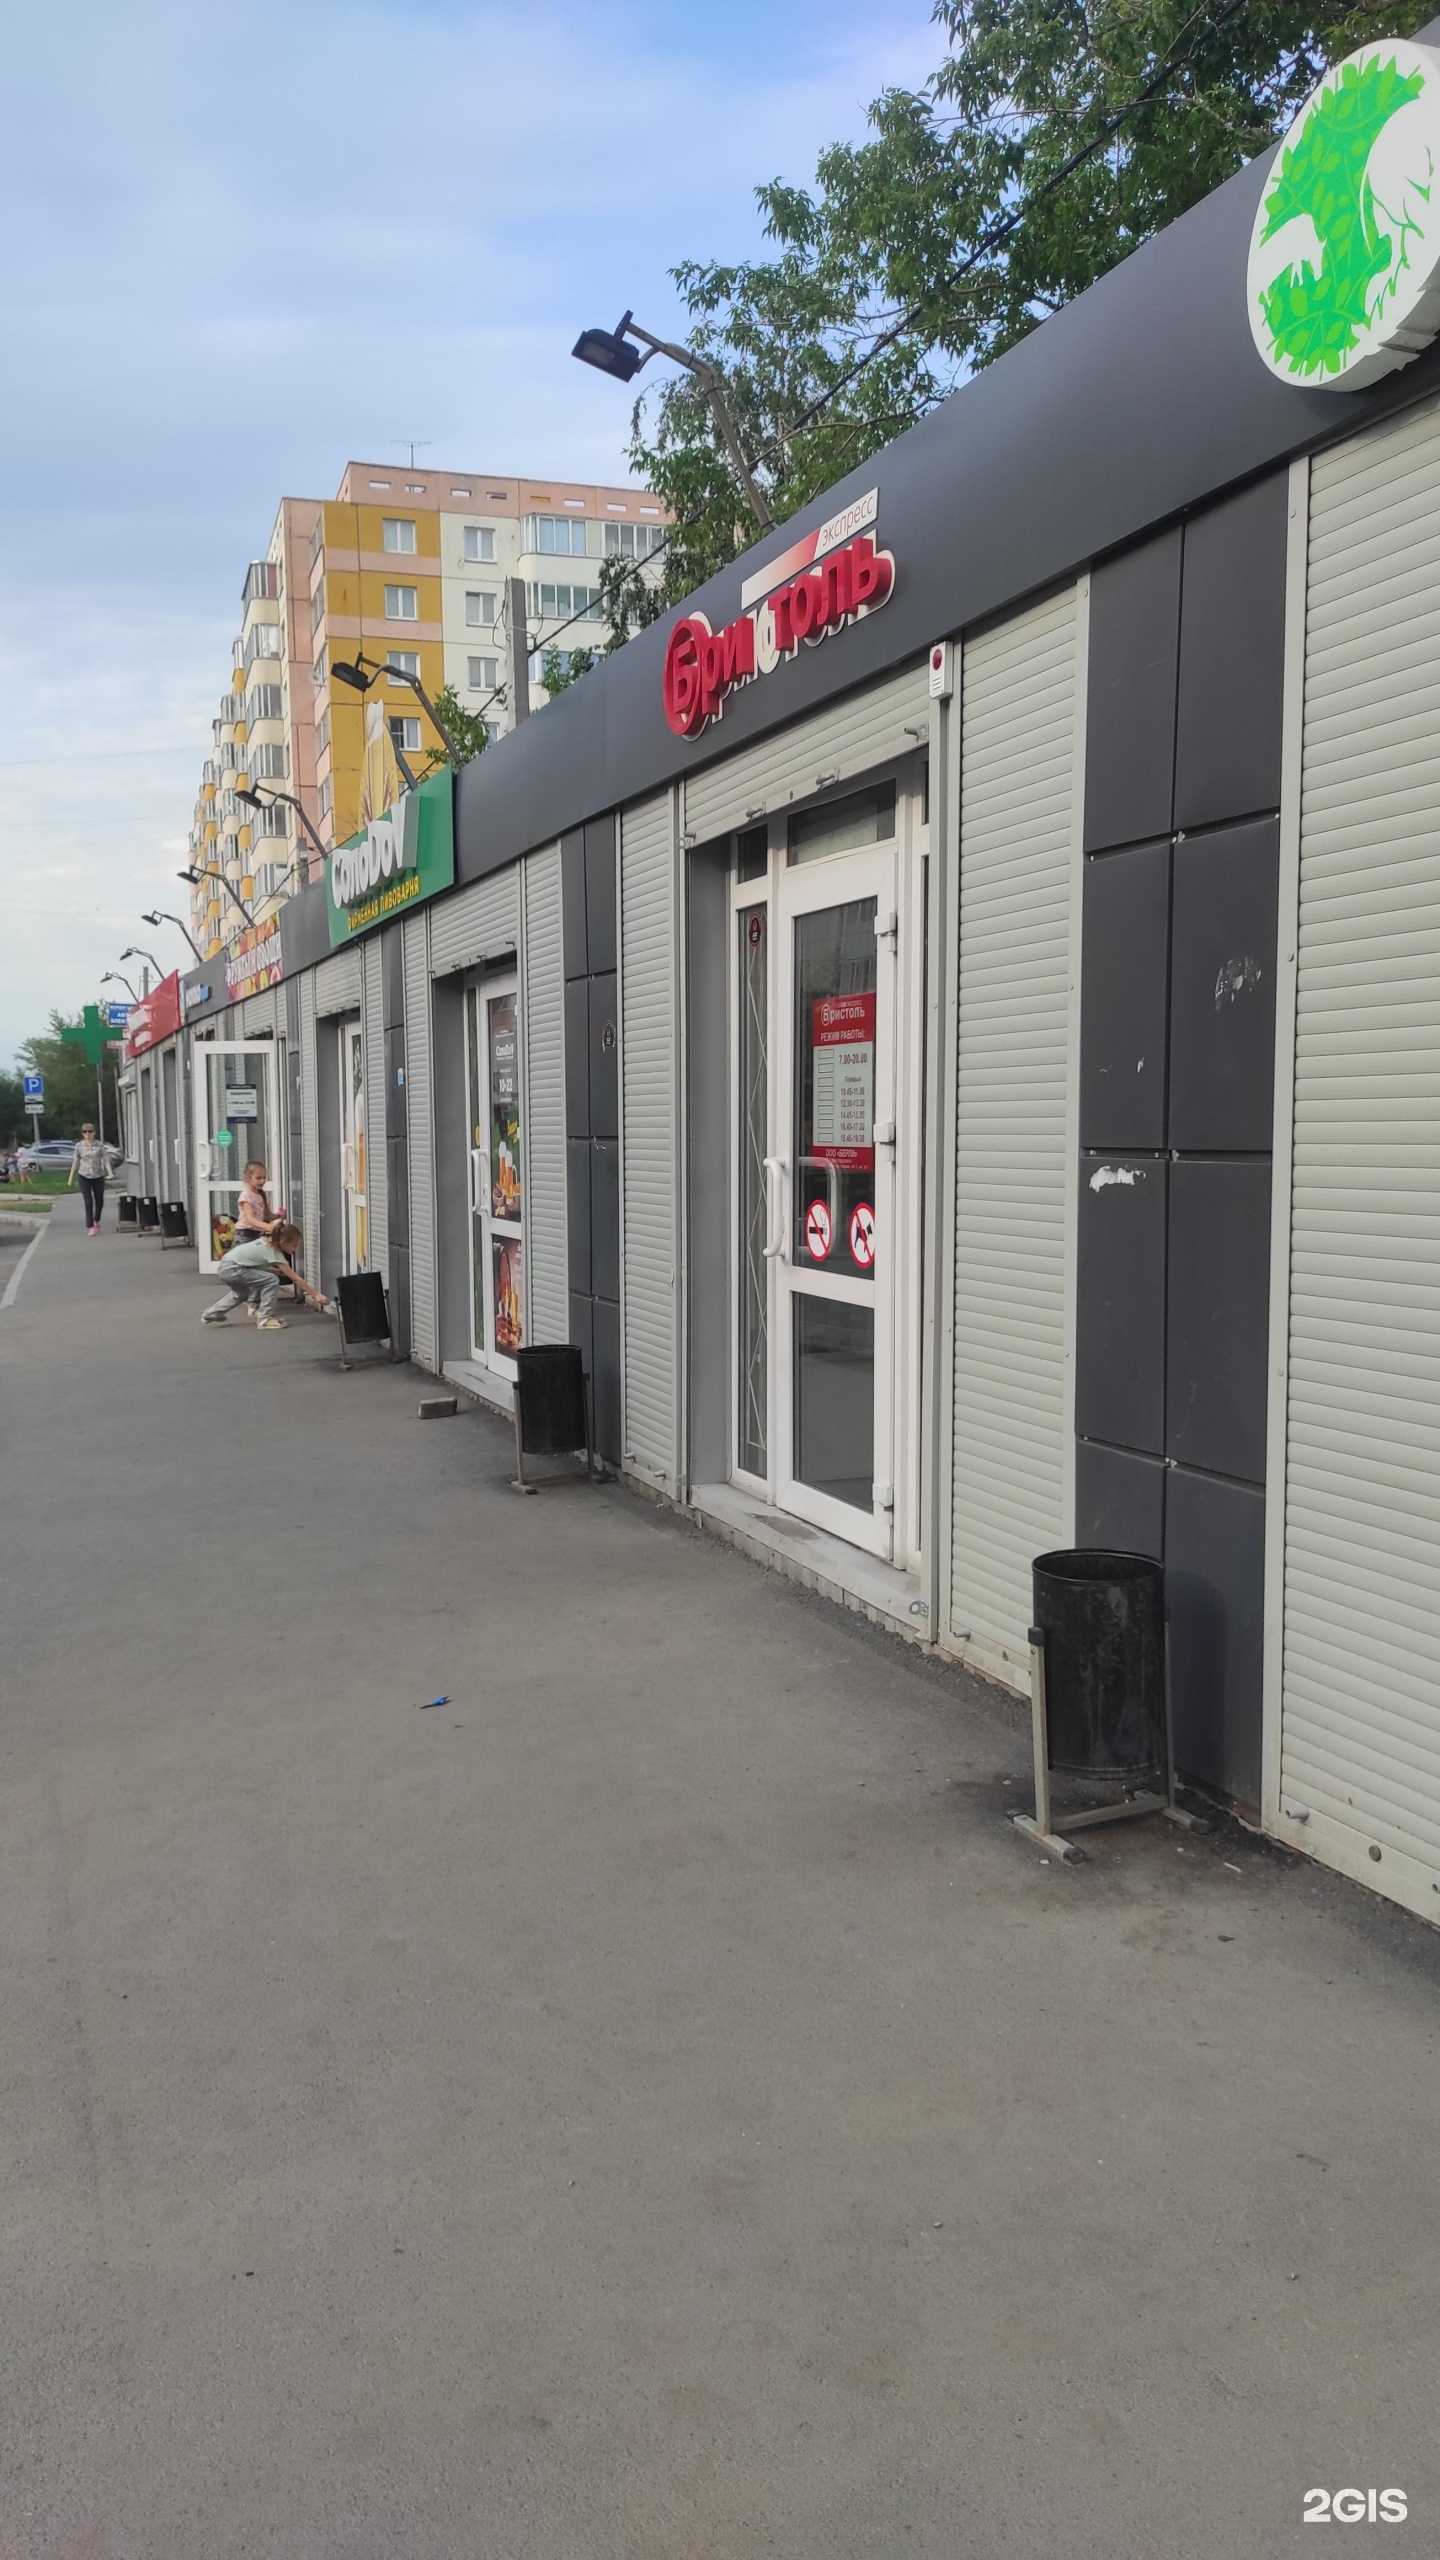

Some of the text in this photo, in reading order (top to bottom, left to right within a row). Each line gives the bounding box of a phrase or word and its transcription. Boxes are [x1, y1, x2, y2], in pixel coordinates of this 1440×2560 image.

[820, 494, 874, 547] экспресс
[663, 532, 895, 739] Бритоль
[820, 1003, 865, 1026] Бристоль
